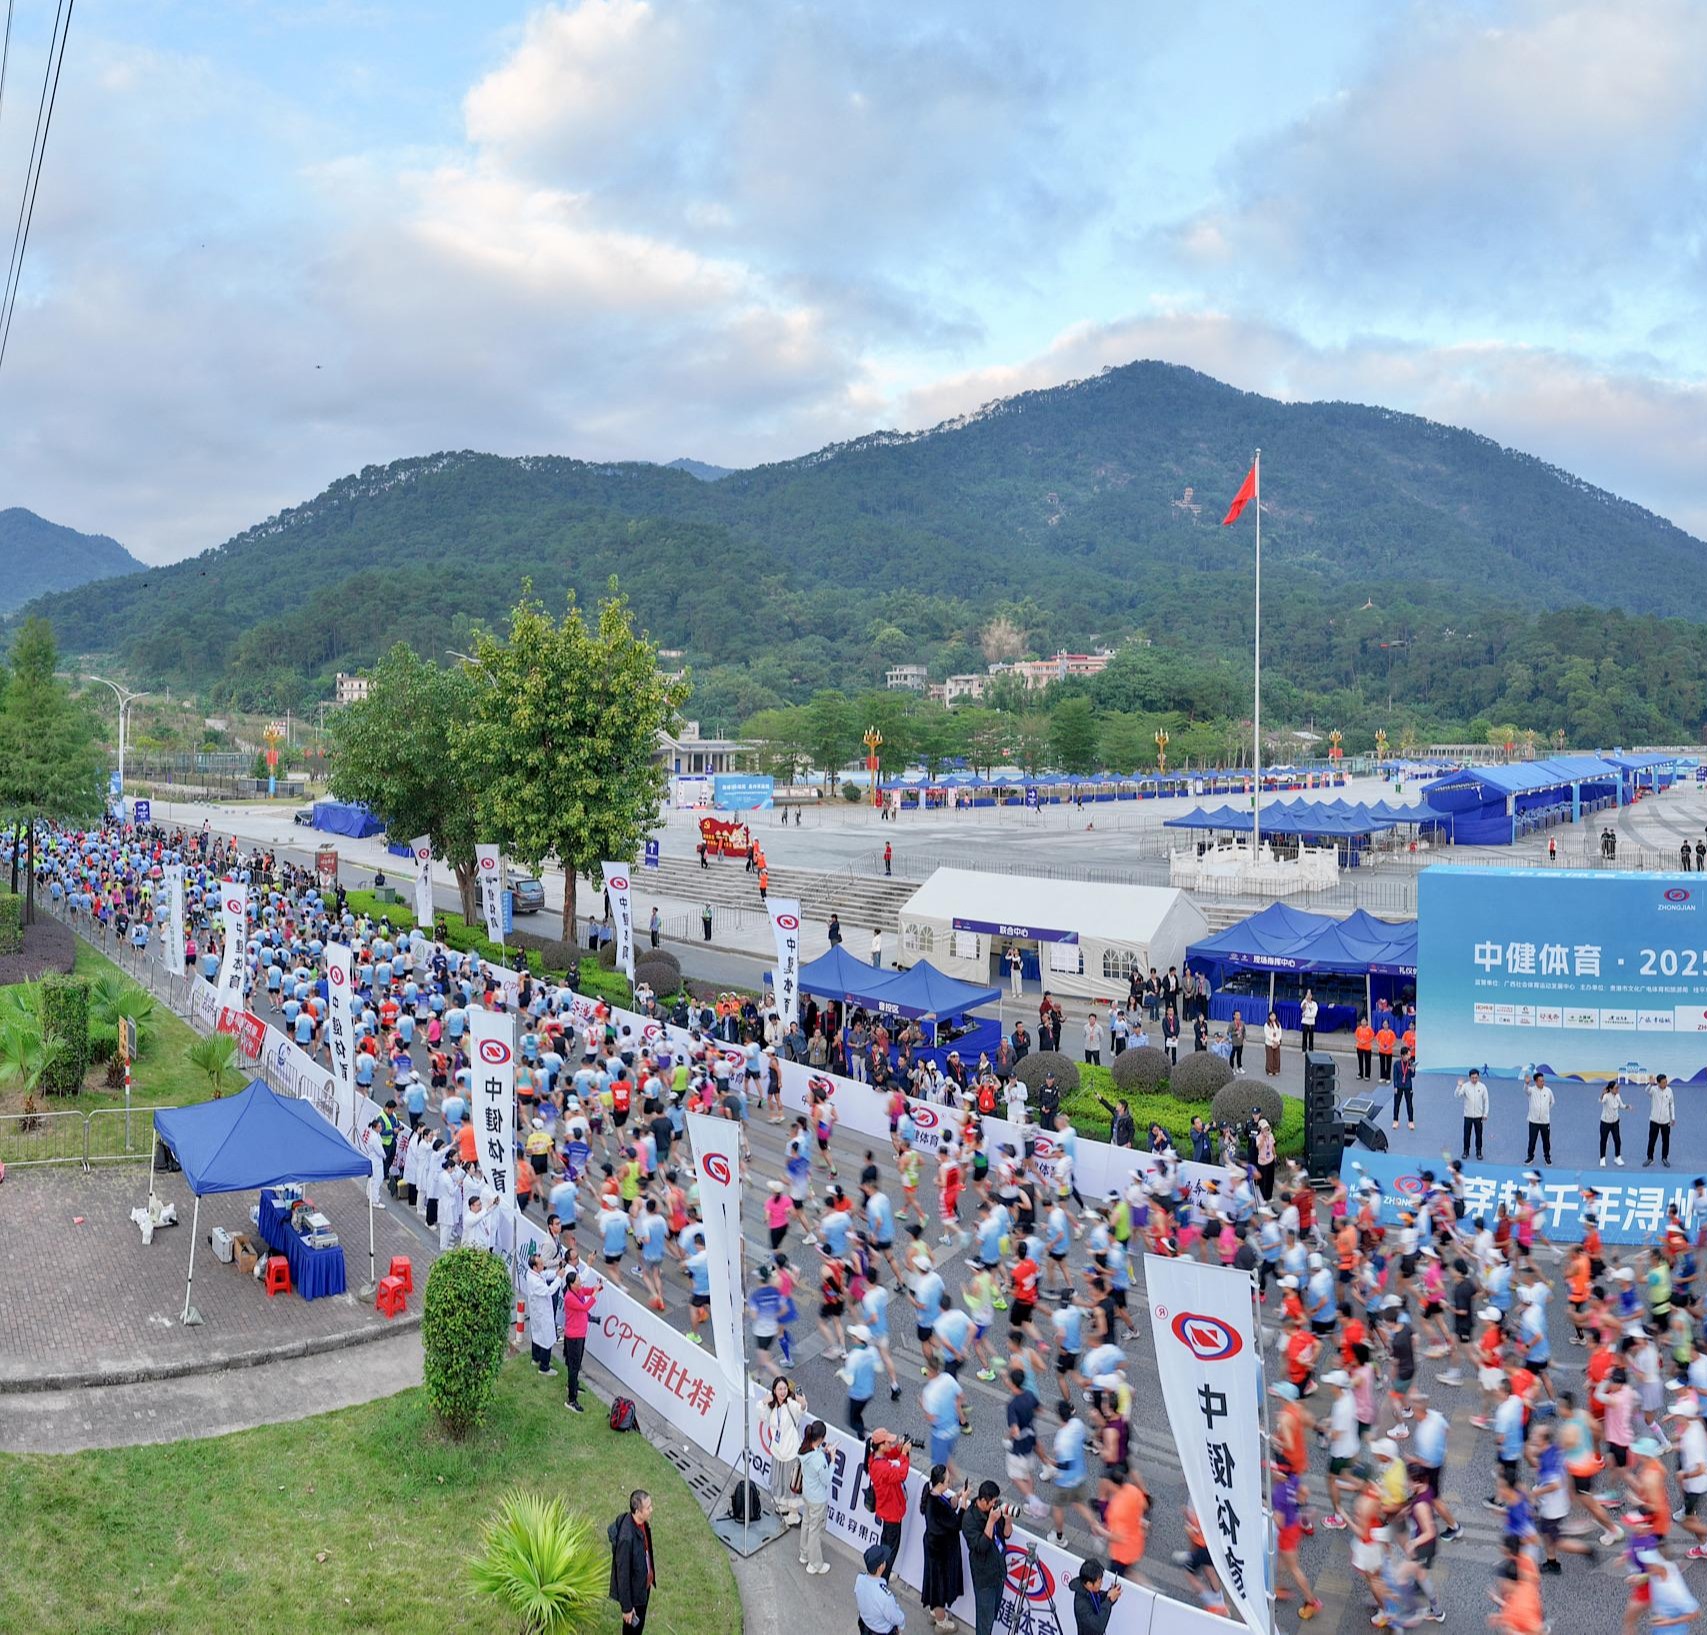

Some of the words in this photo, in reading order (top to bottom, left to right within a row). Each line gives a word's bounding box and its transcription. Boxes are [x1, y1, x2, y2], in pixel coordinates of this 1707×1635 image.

[603, 1314, 647, 1358] CPT
[641, 1345, 716, 1417] 康比特
